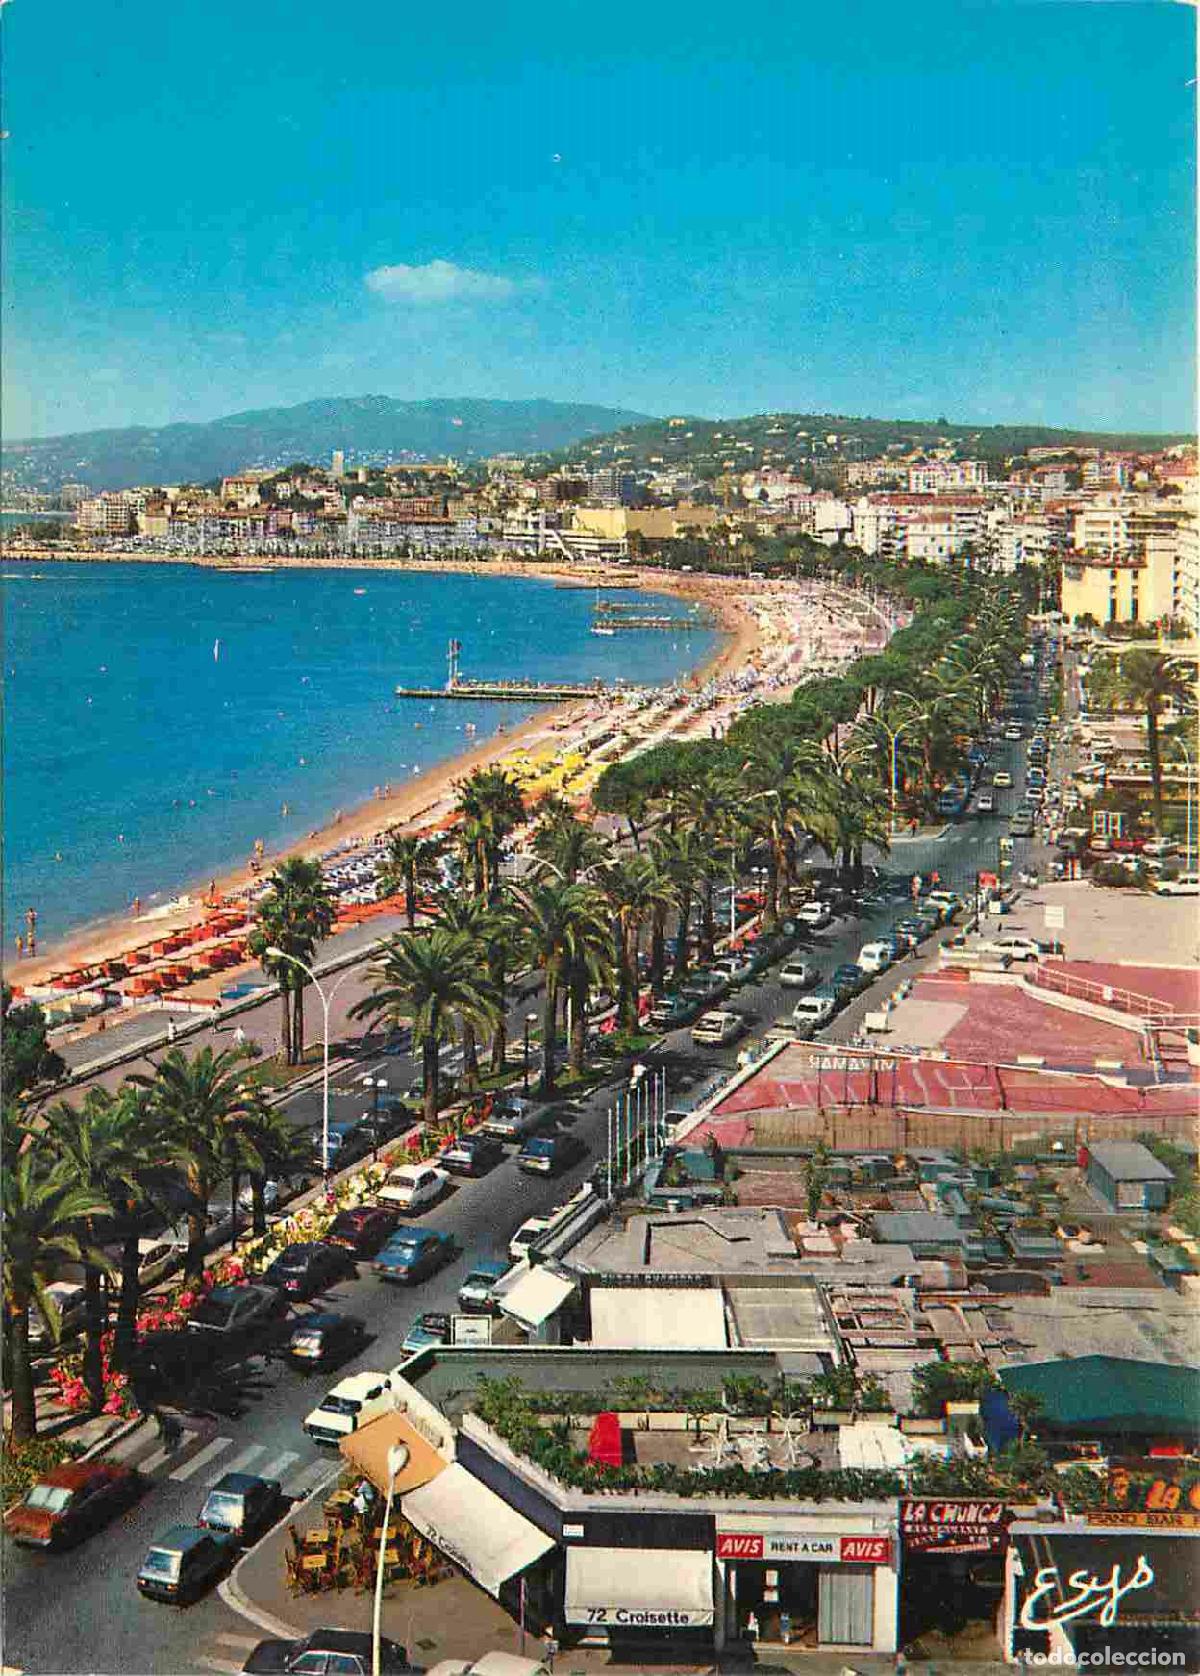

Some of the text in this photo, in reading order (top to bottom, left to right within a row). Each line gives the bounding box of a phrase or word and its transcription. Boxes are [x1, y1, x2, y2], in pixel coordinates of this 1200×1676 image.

[905, 1502, 926, 1521] LA
[721, 1538, 762, 1554] AVIS
[771, 1542, 833, 1553] RENT A CAR
[843, 1541, 885, 1557] AVIS
[587, 1608, 689, 1624] 72 Croisette
